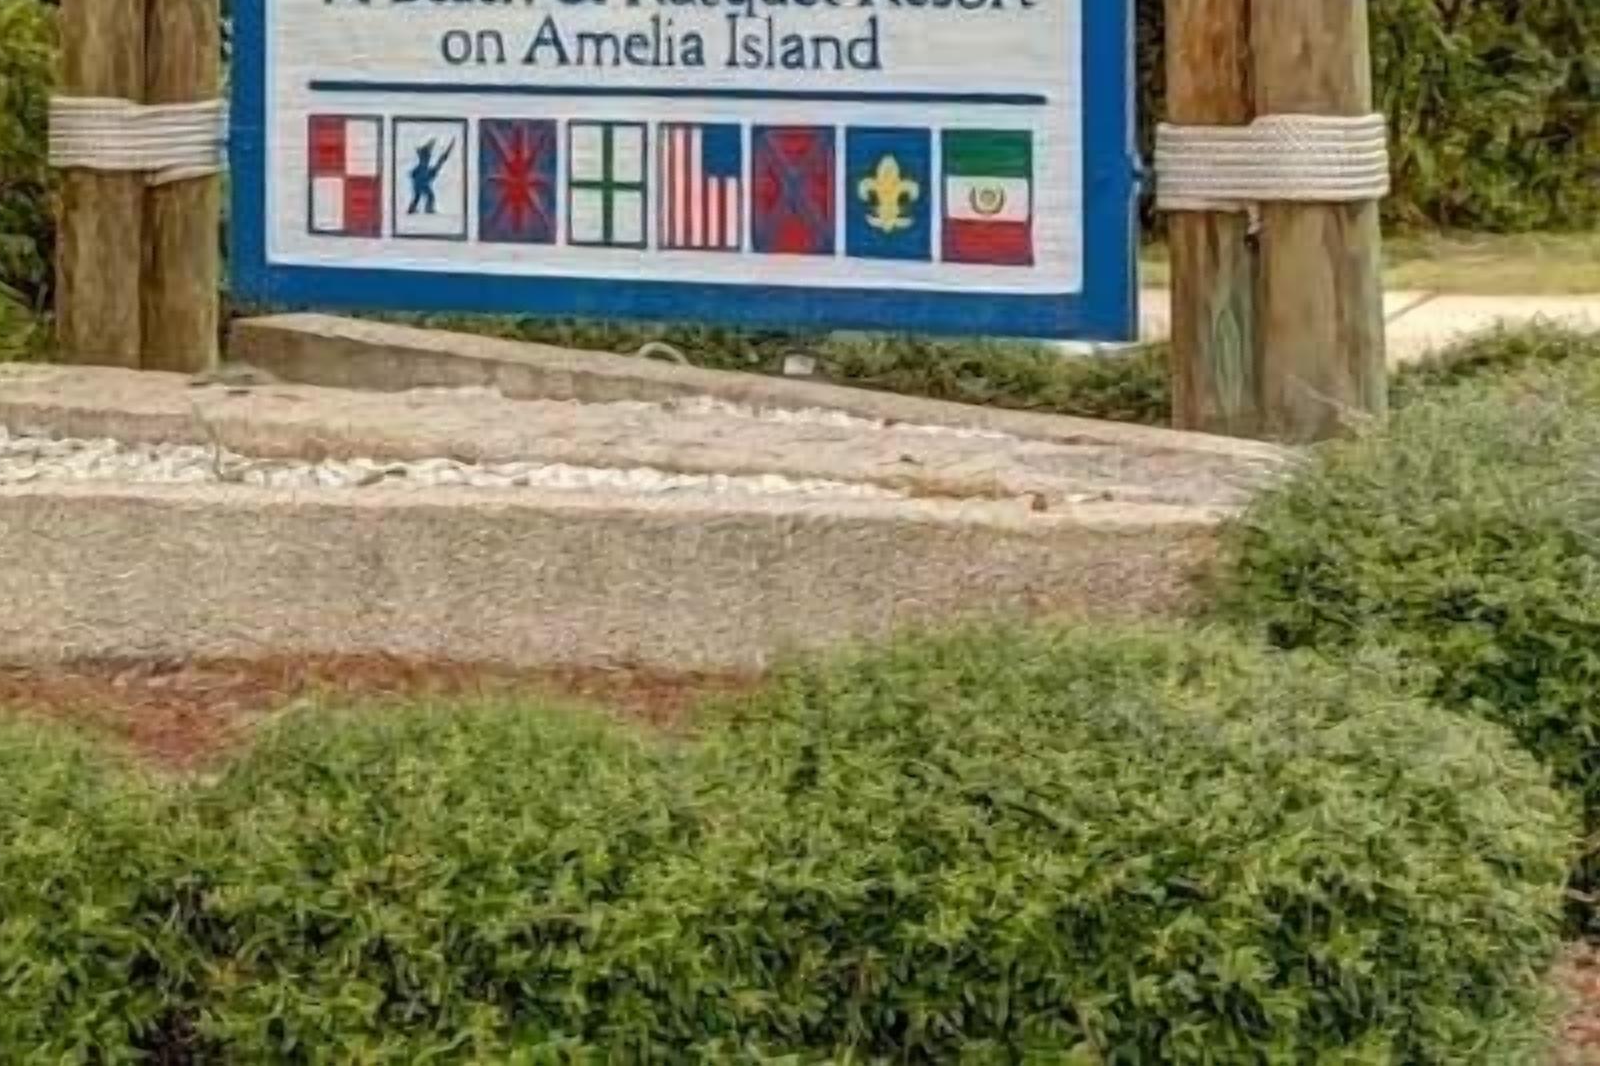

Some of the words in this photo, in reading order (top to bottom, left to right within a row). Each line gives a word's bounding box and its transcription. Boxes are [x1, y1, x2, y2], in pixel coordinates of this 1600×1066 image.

[440, 25, 505, 66] on
[523, 14, 706, 68] Amelia
[725, 14, 882, 71] Island
